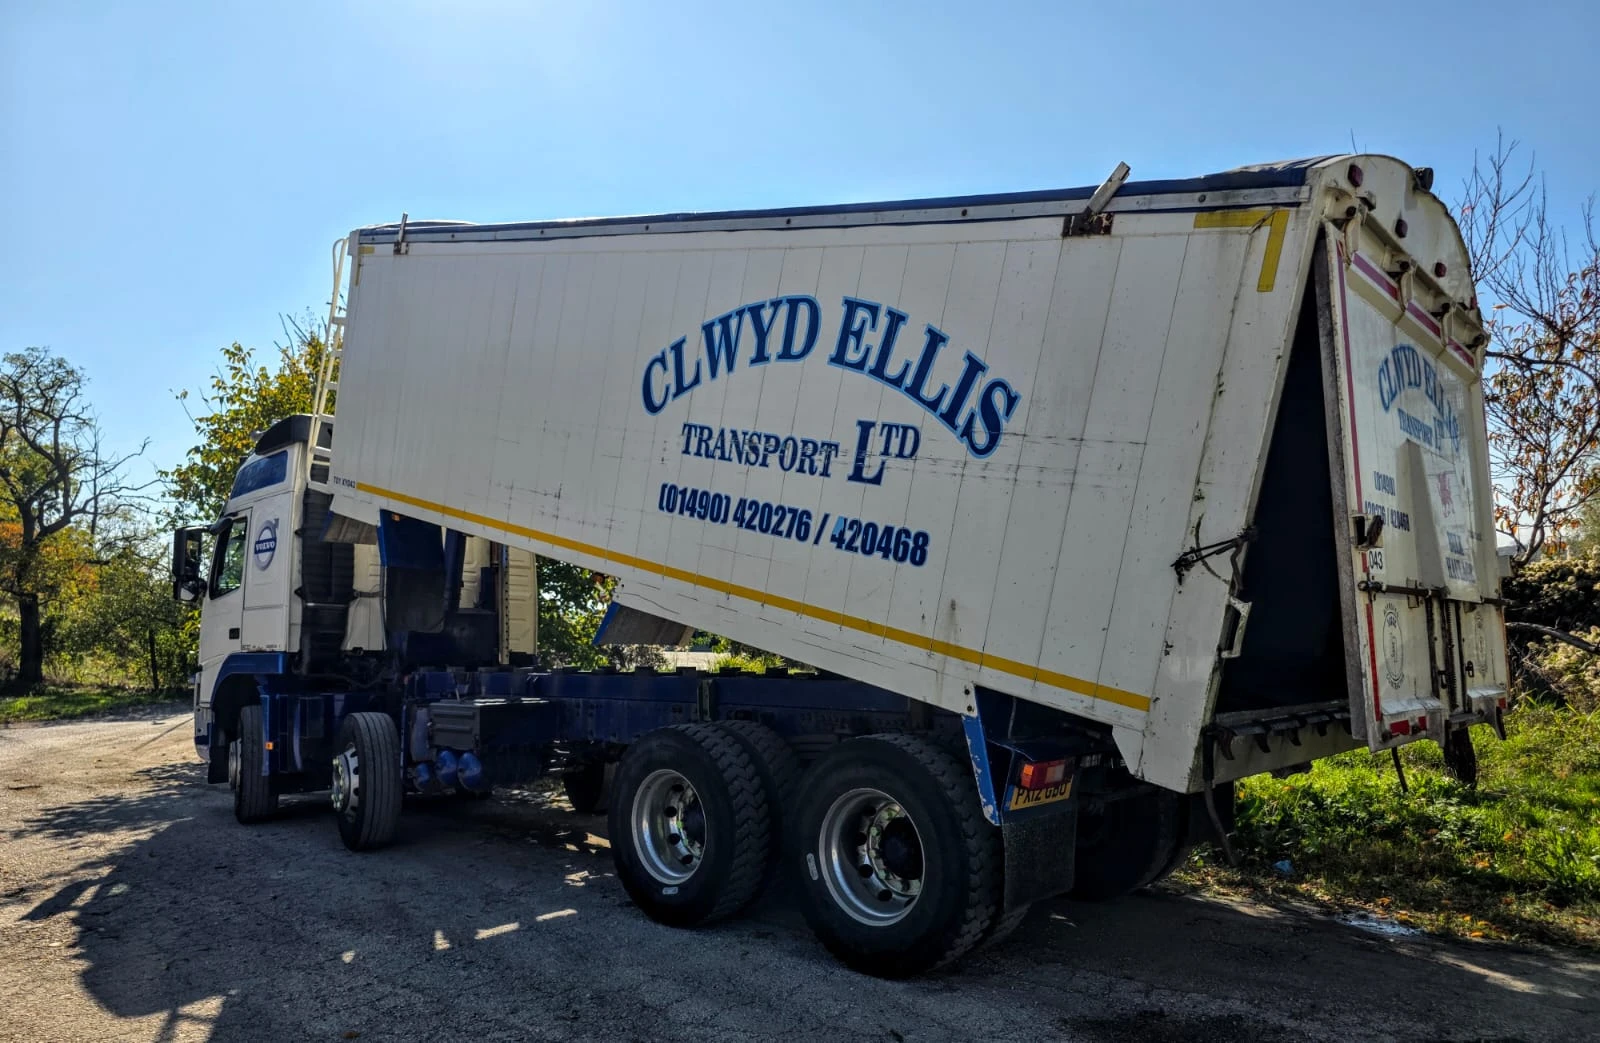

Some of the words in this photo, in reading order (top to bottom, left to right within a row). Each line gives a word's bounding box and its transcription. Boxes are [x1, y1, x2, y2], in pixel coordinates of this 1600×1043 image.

[641, 295, 822, 416] CLWYD
[827, 296, 1021, 459] ELLIS
[1378, 345, 1421, 413] CLWYD
[681, 423, 839, 478] TRANSPORT
[255, 541, 275, 552] VOLVO
[658, 483, 732, 524] (01490)
[733, 497, 812, 545] 420276
[813, 513, 830, 545] /
[830, 515, 930, 567] 420468
[1368, 550, 1383, 570] 043
